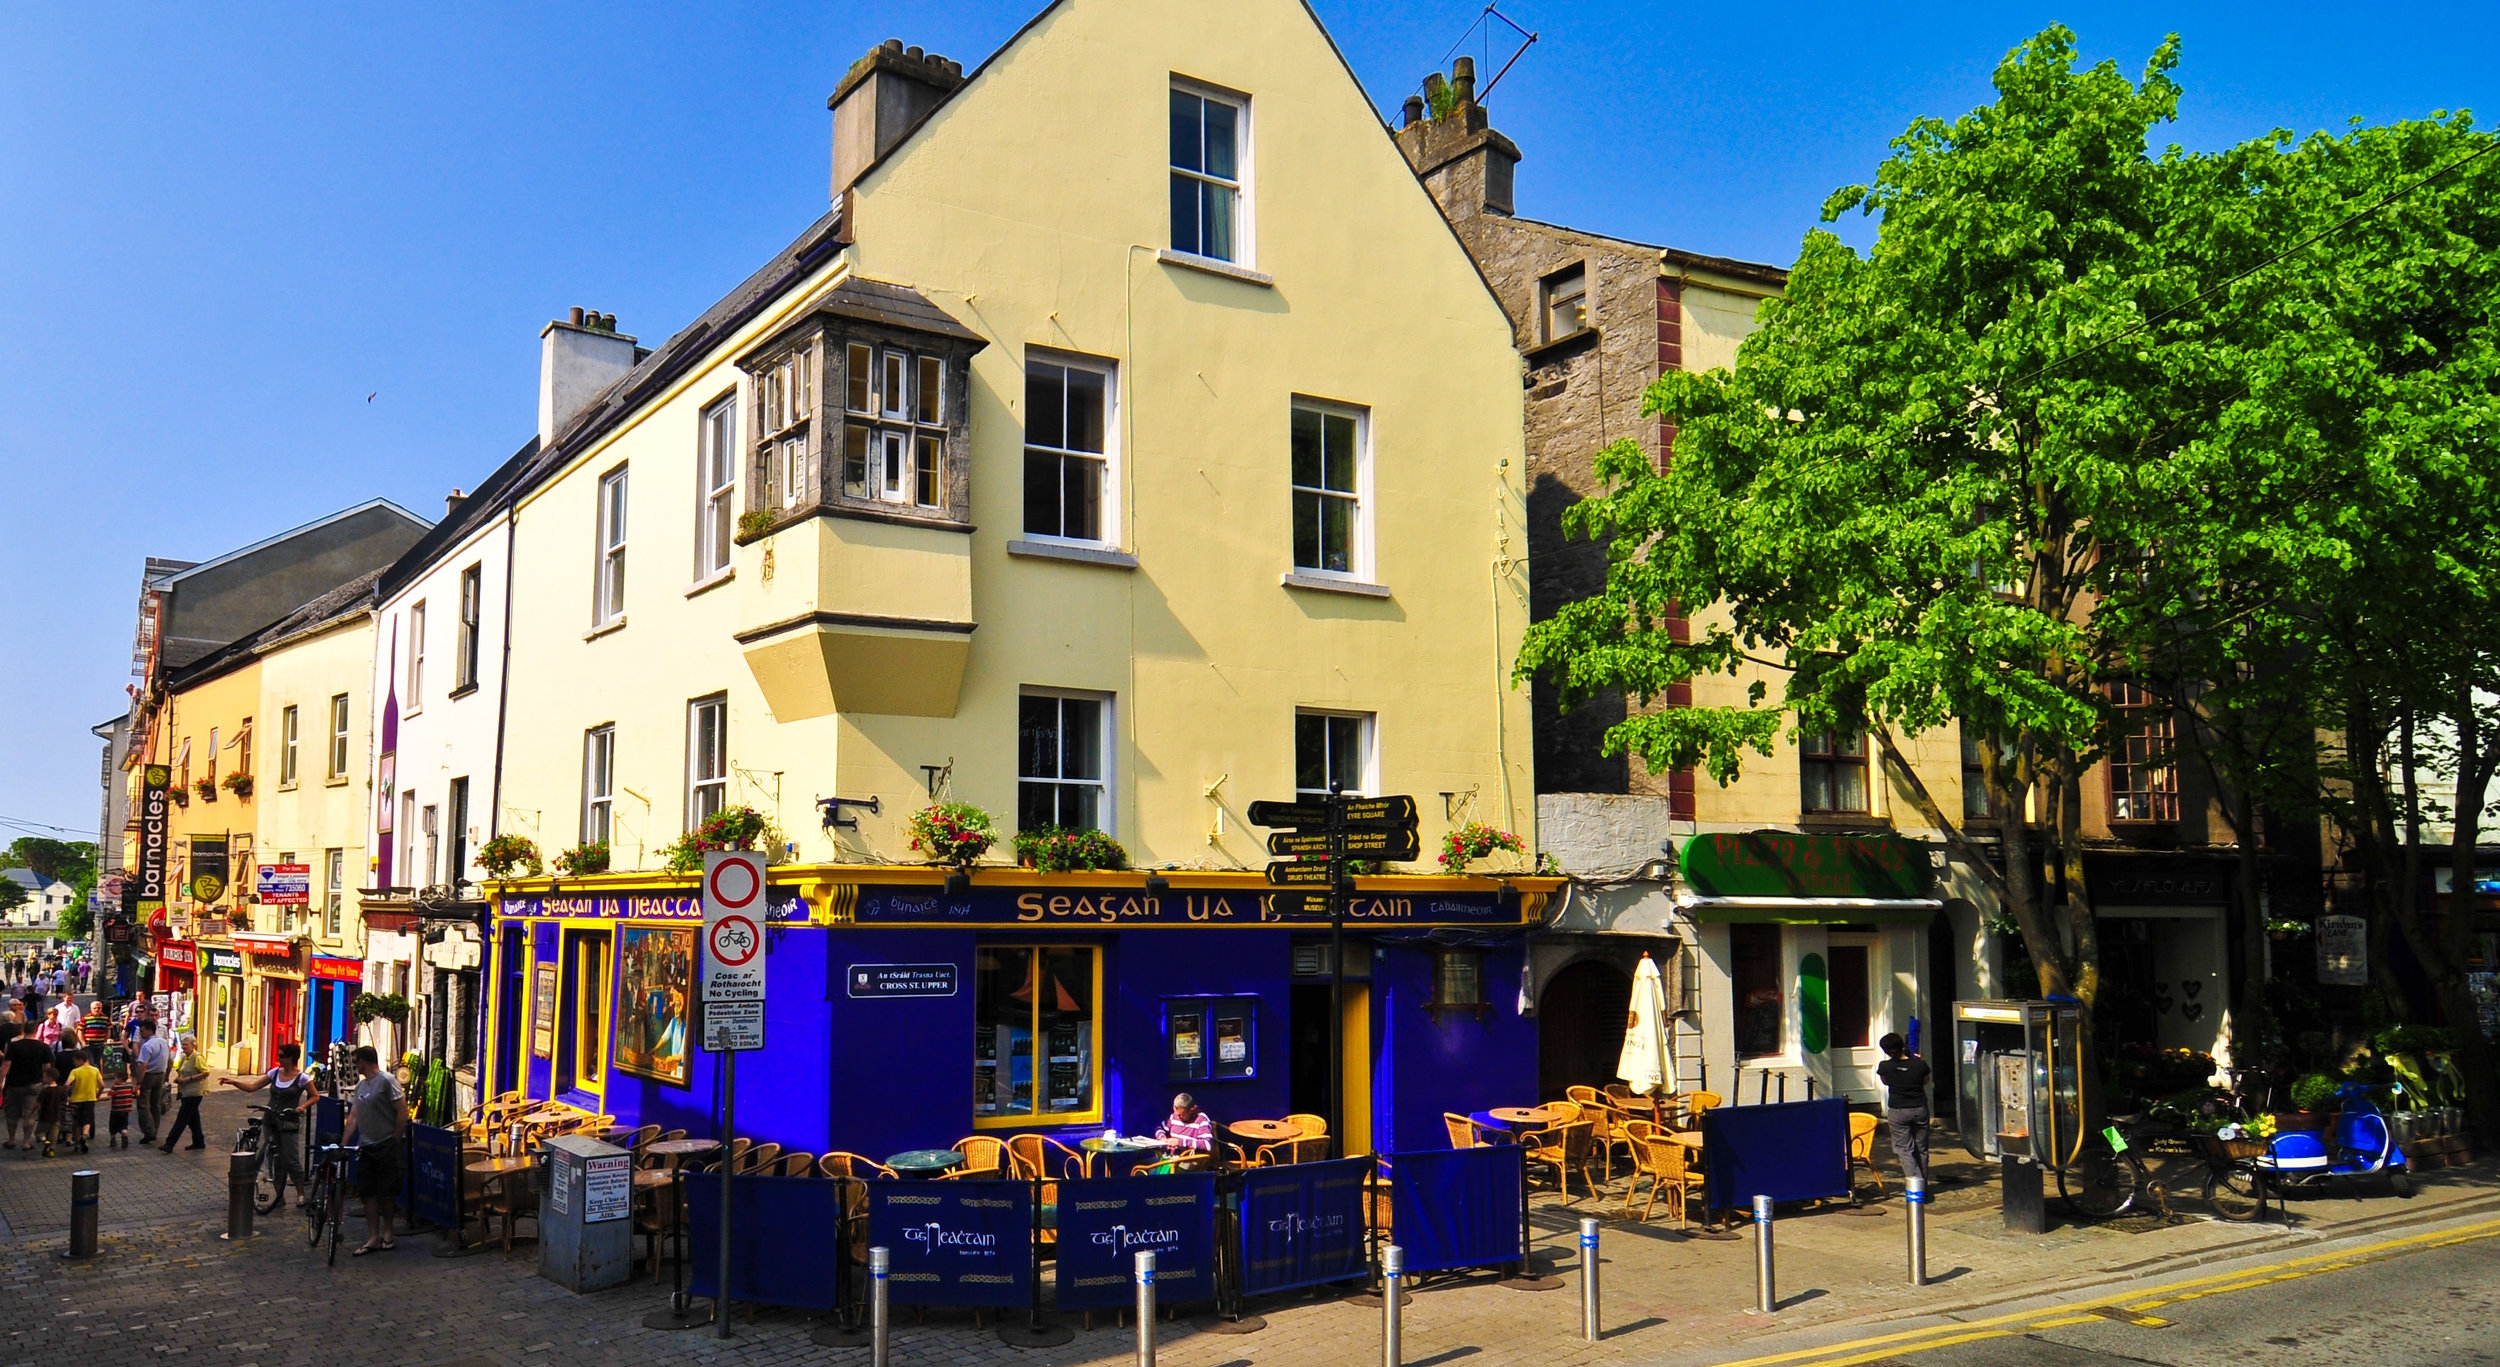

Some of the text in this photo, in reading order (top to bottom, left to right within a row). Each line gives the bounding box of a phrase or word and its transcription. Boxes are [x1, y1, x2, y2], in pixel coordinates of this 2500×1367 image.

[1346, 811, 1385, 820] EYRE SQUARE
[141, 790, 164, 897] barnacles
[1363, 841, 1386, 849] STREET
[1802, 835, 1822, 870] &
[1303, 873, 1327, 881] THEATRE
[346, 966, 358, 977] Store
[715, 972, 739, 980] Cosc
[911, 971, 934, 979] Trasna
[879, 981, 948, 990] CROSS ST. UPPER
[724, 989, 759, 998] Cycling
[588, 1159, 629, 1169] Warning
[597, 1202, 628, 1211] Designated
